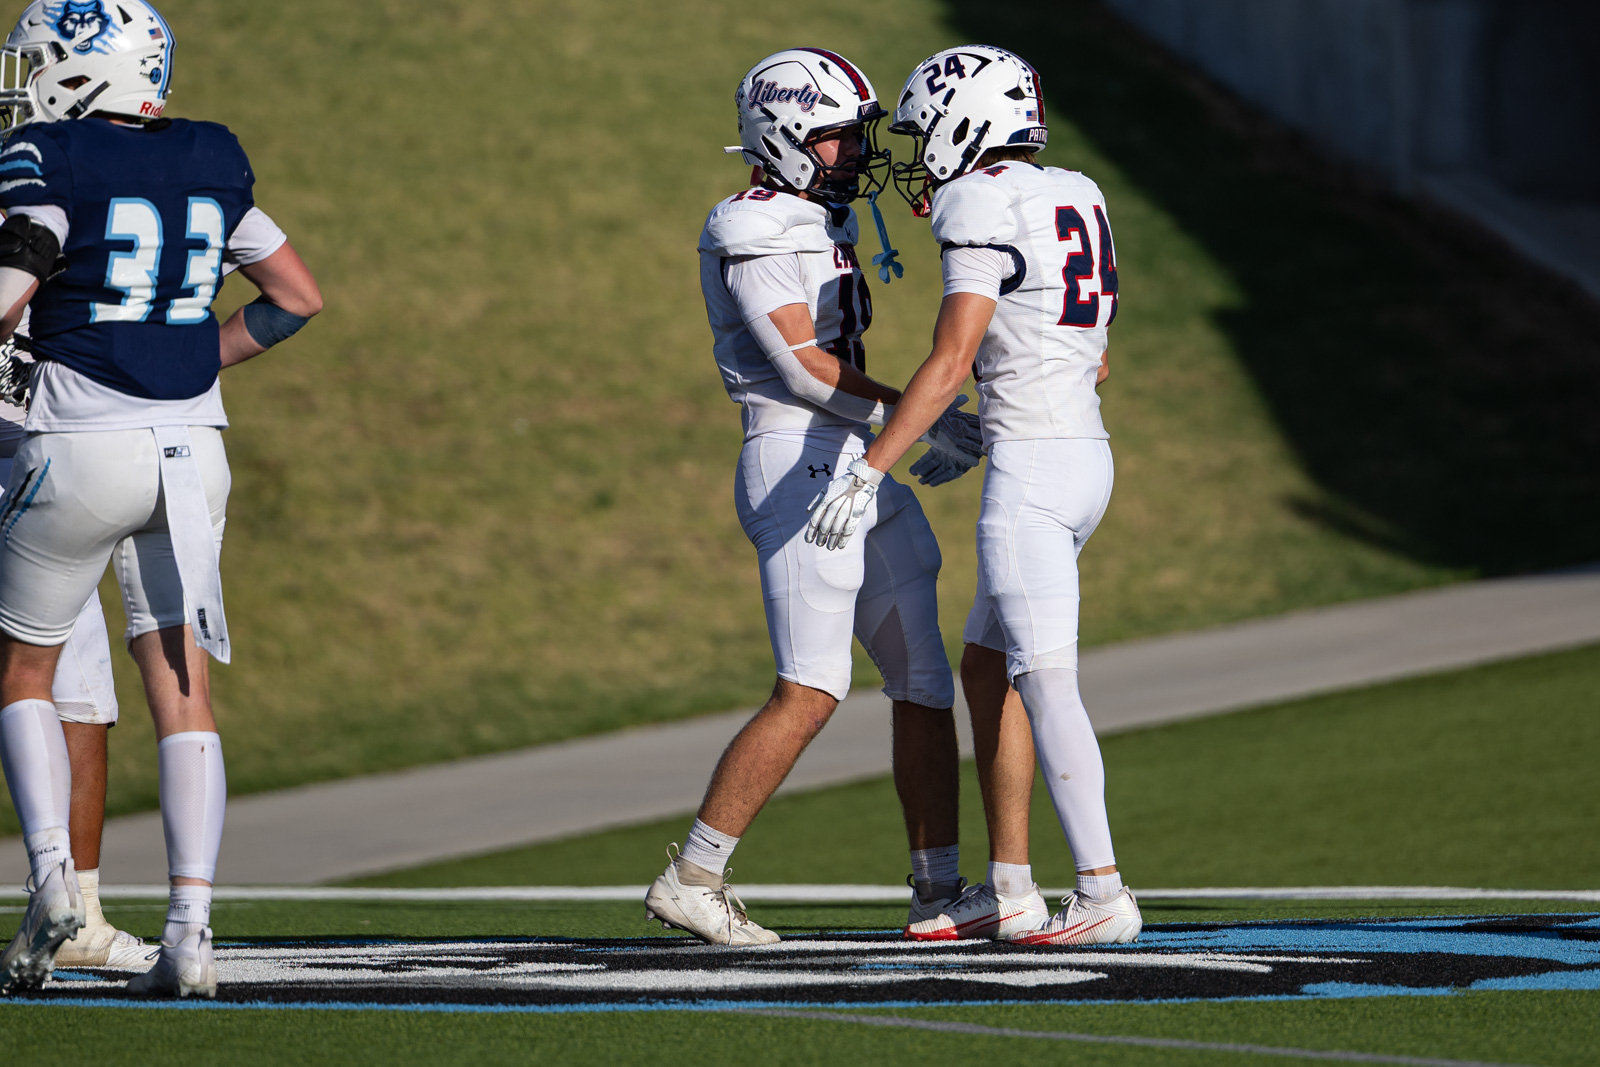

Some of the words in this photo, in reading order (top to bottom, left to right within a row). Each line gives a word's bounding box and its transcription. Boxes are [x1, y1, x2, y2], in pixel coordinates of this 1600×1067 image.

[748, 79, 822, 112] Liberty
[923, 54, 966, 96] 24
[729, 188, 778, 204] 19
[89, 196, 225, 325] 33
[1055, 204, 1119, 328] 24
